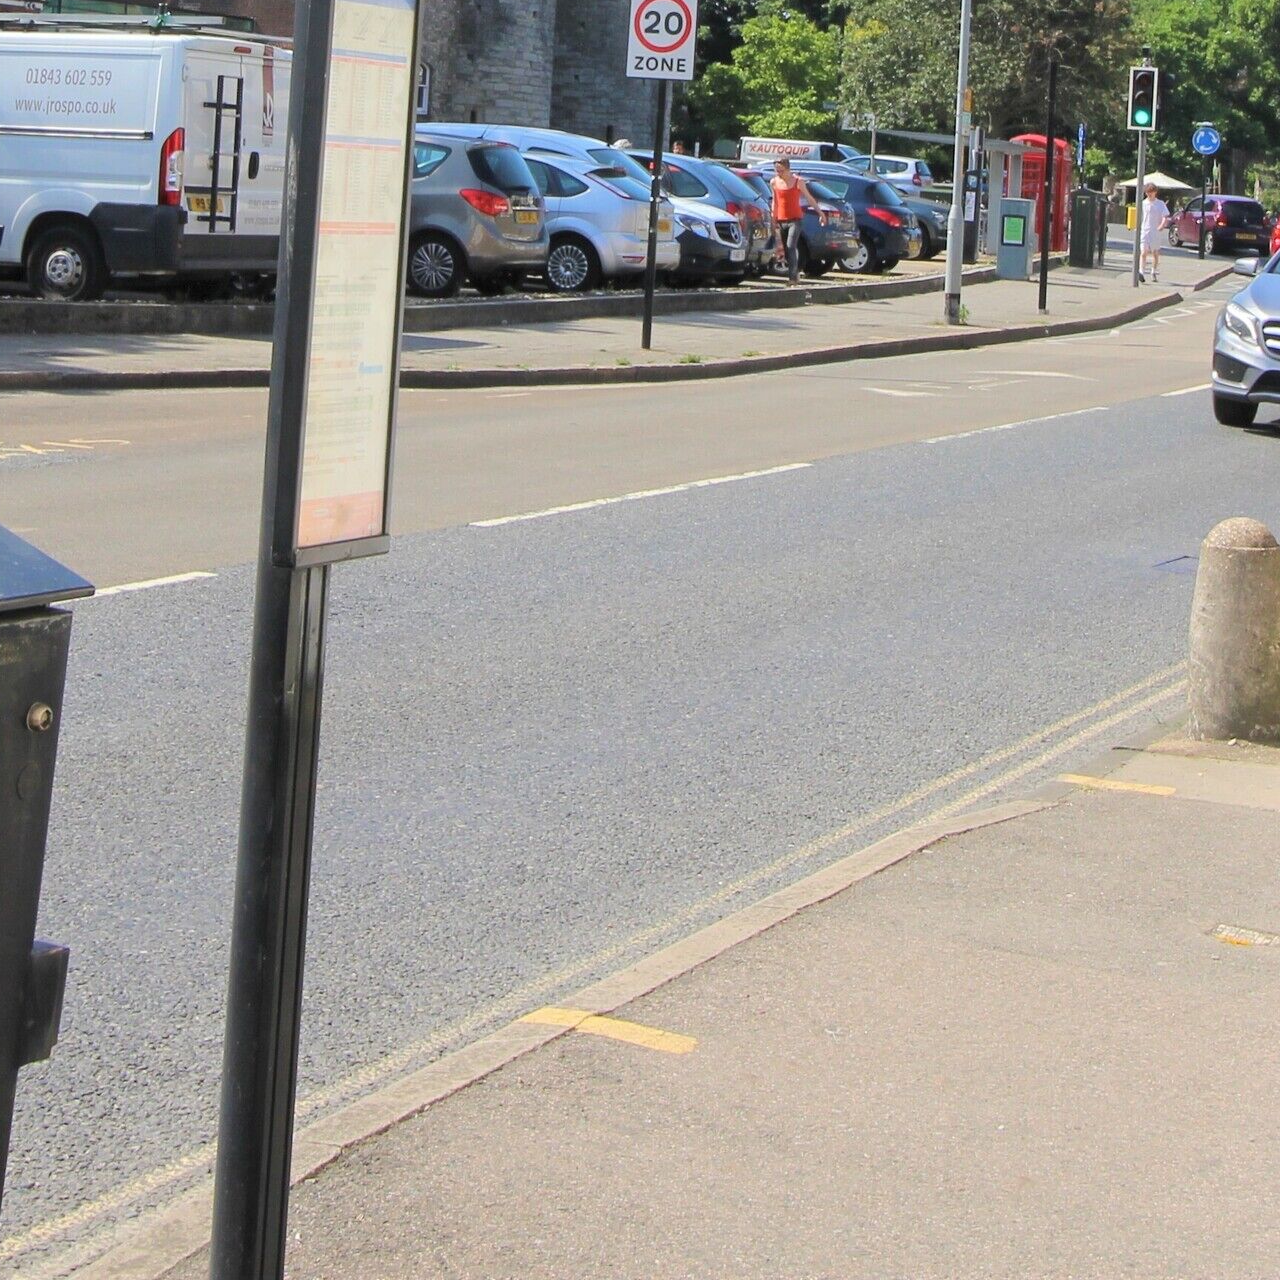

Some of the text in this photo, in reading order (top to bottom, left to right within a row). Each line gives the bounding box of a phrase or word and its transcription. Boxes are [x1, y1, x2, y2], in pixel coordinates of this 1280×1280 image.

[644, 10, 683, 35] 20
[634, 56, 686, 73] ZONE
[26, 68, 112, 86] 01843 602 559
[15, 96, 117, 115] www.jrospo.co.uk
[756, 144, 810, 156] AUTOQUIP
